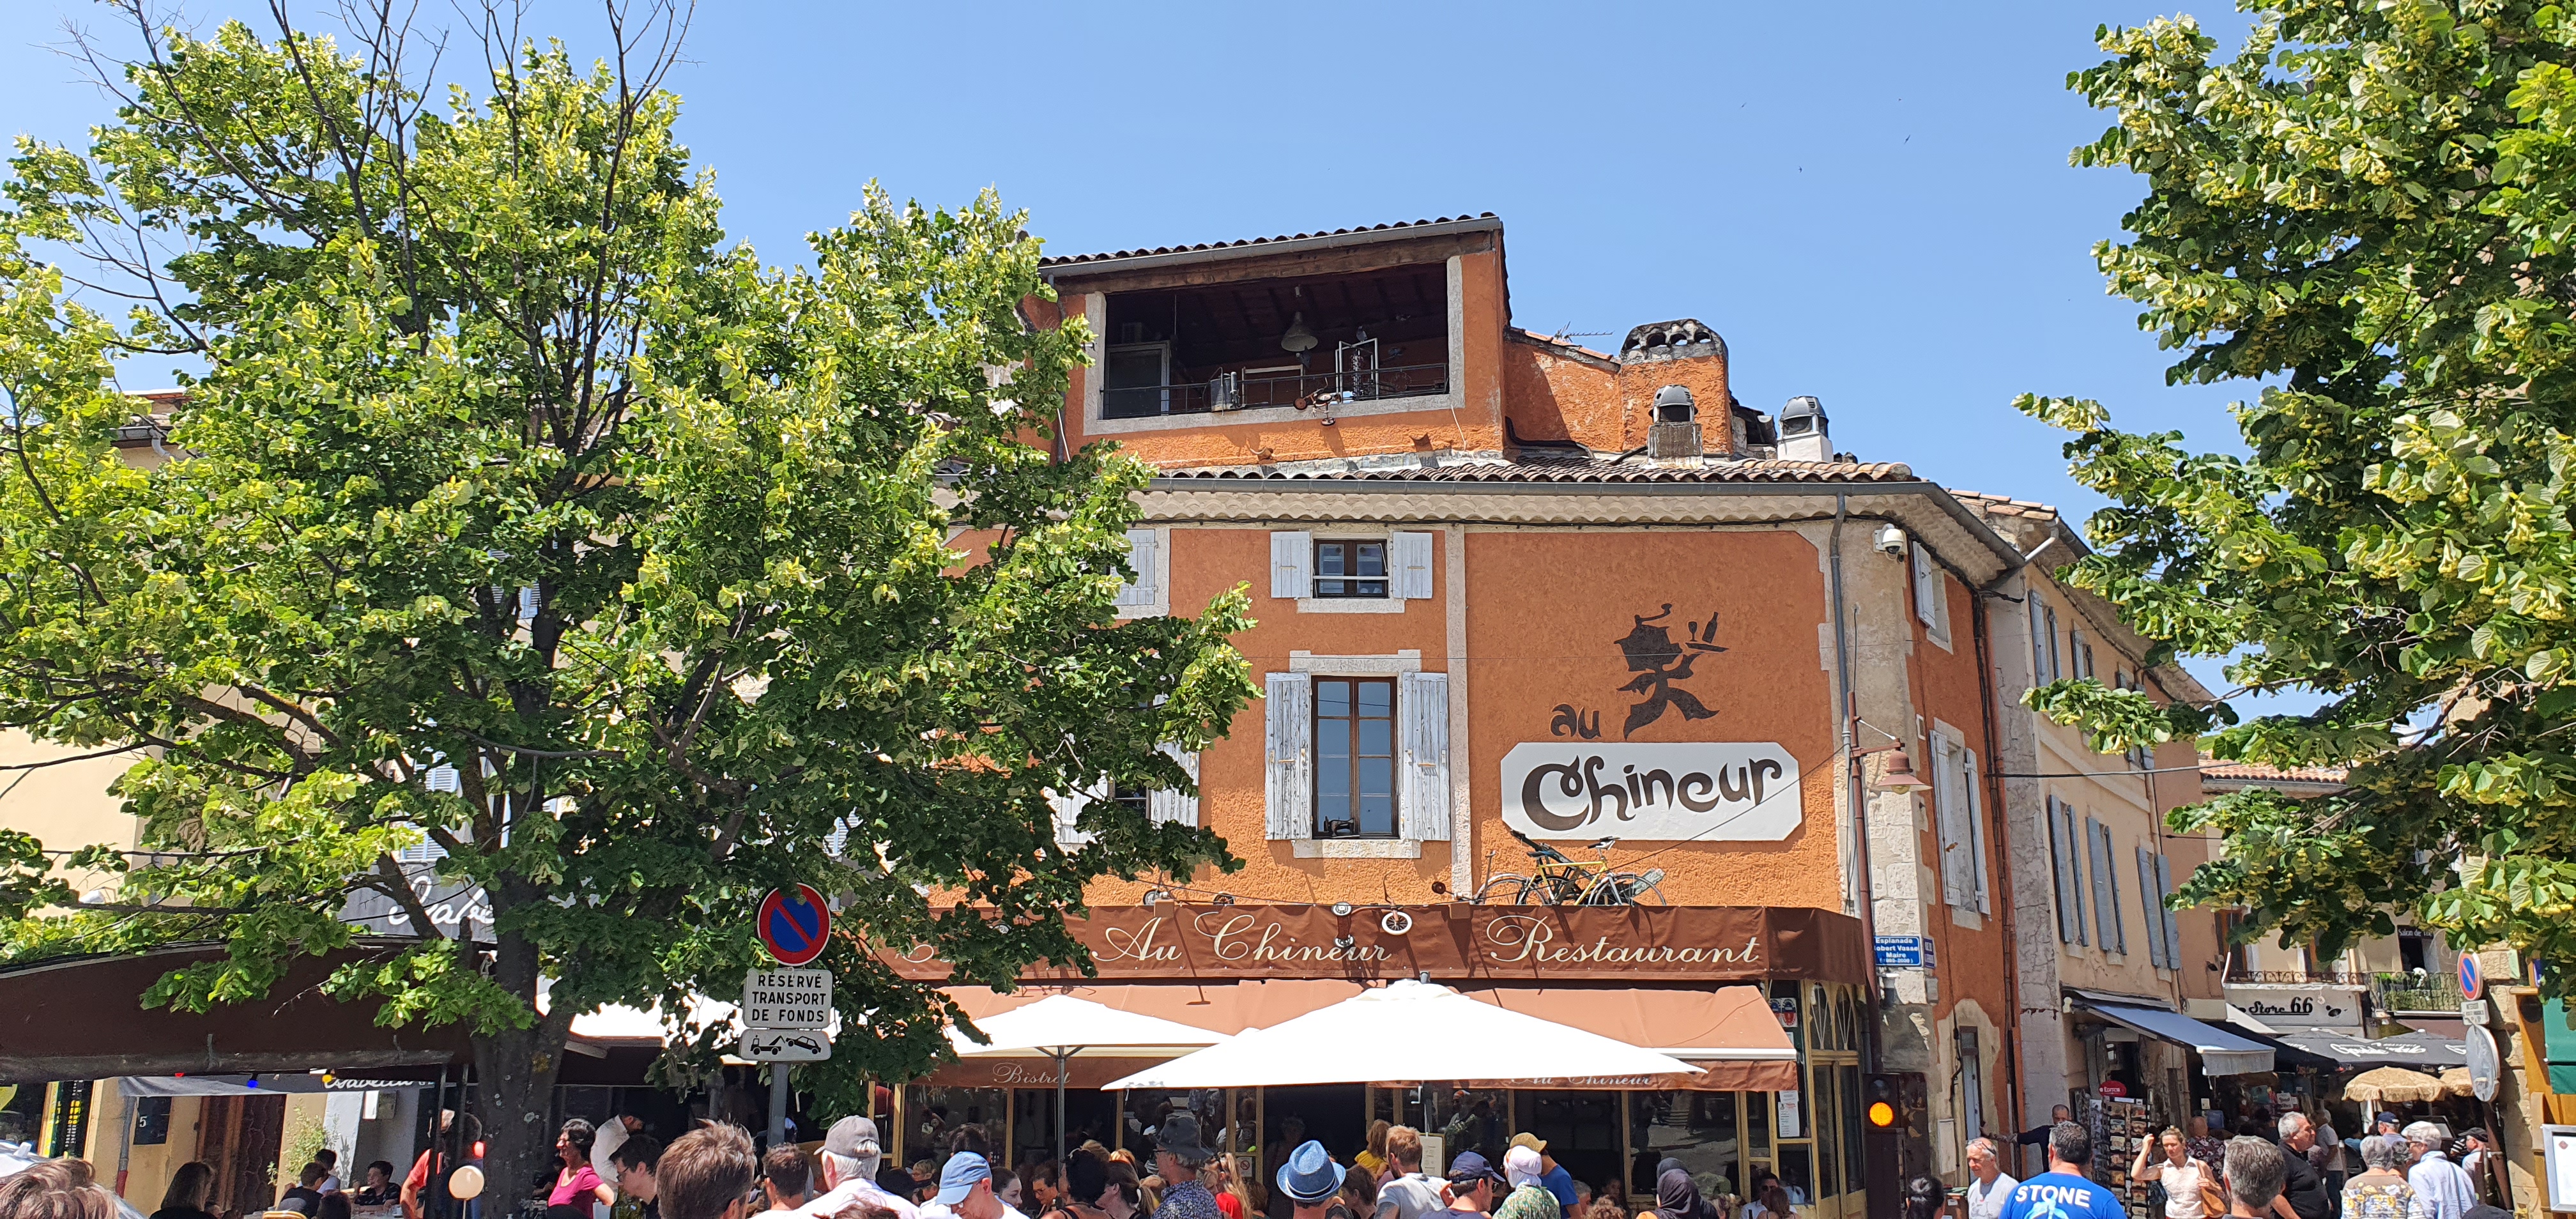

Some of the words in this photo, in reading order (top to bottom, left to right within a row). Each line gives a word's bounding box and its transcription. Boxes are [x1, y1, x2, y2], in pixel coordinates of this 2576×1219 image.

[1549, 703, 1602, 739] au
[1521, 755, 1782, 831] Chineur
[1091, 917, 1182, 962] Au
[1194, 911, 1392, 961] Chineur
[1486, 915, 1760, 963] Restaurant
[752, 991, 827, 1005] TRANSPORT
[2290, 996, 2313, 1013] 66
[752, 1008, 769, 1022] DE
[779, 1009, 824, 1022] FONDS
[139, 1116, 148, 1128] 5
[2014, 1184, 2092, 1208] STONE
